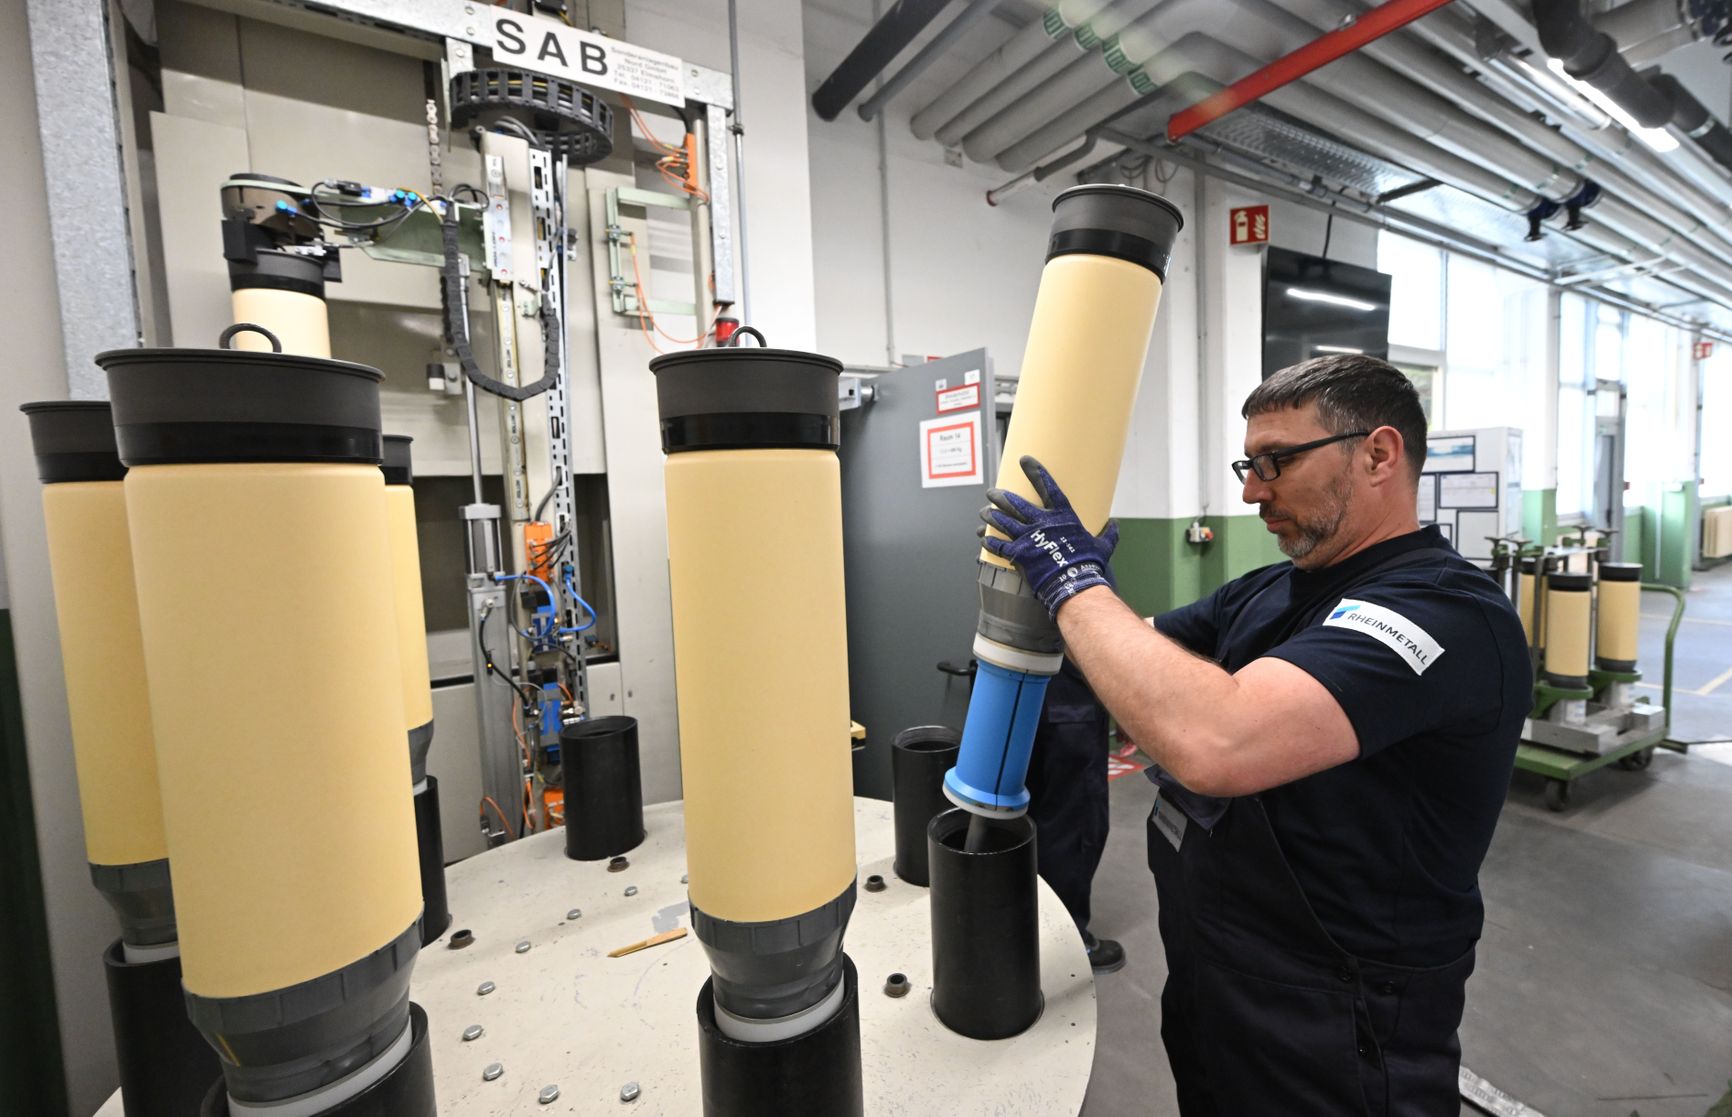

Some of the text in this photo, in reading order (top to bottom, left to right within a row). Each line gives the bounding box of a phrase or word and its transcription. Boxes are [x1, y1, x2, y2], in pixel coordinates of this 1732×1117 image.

[496, 19, 608, 75] SAB
[1030, 529, 1069, 567] HyFlex
[1348, 613, 1429, 665] RHEINMETALL
